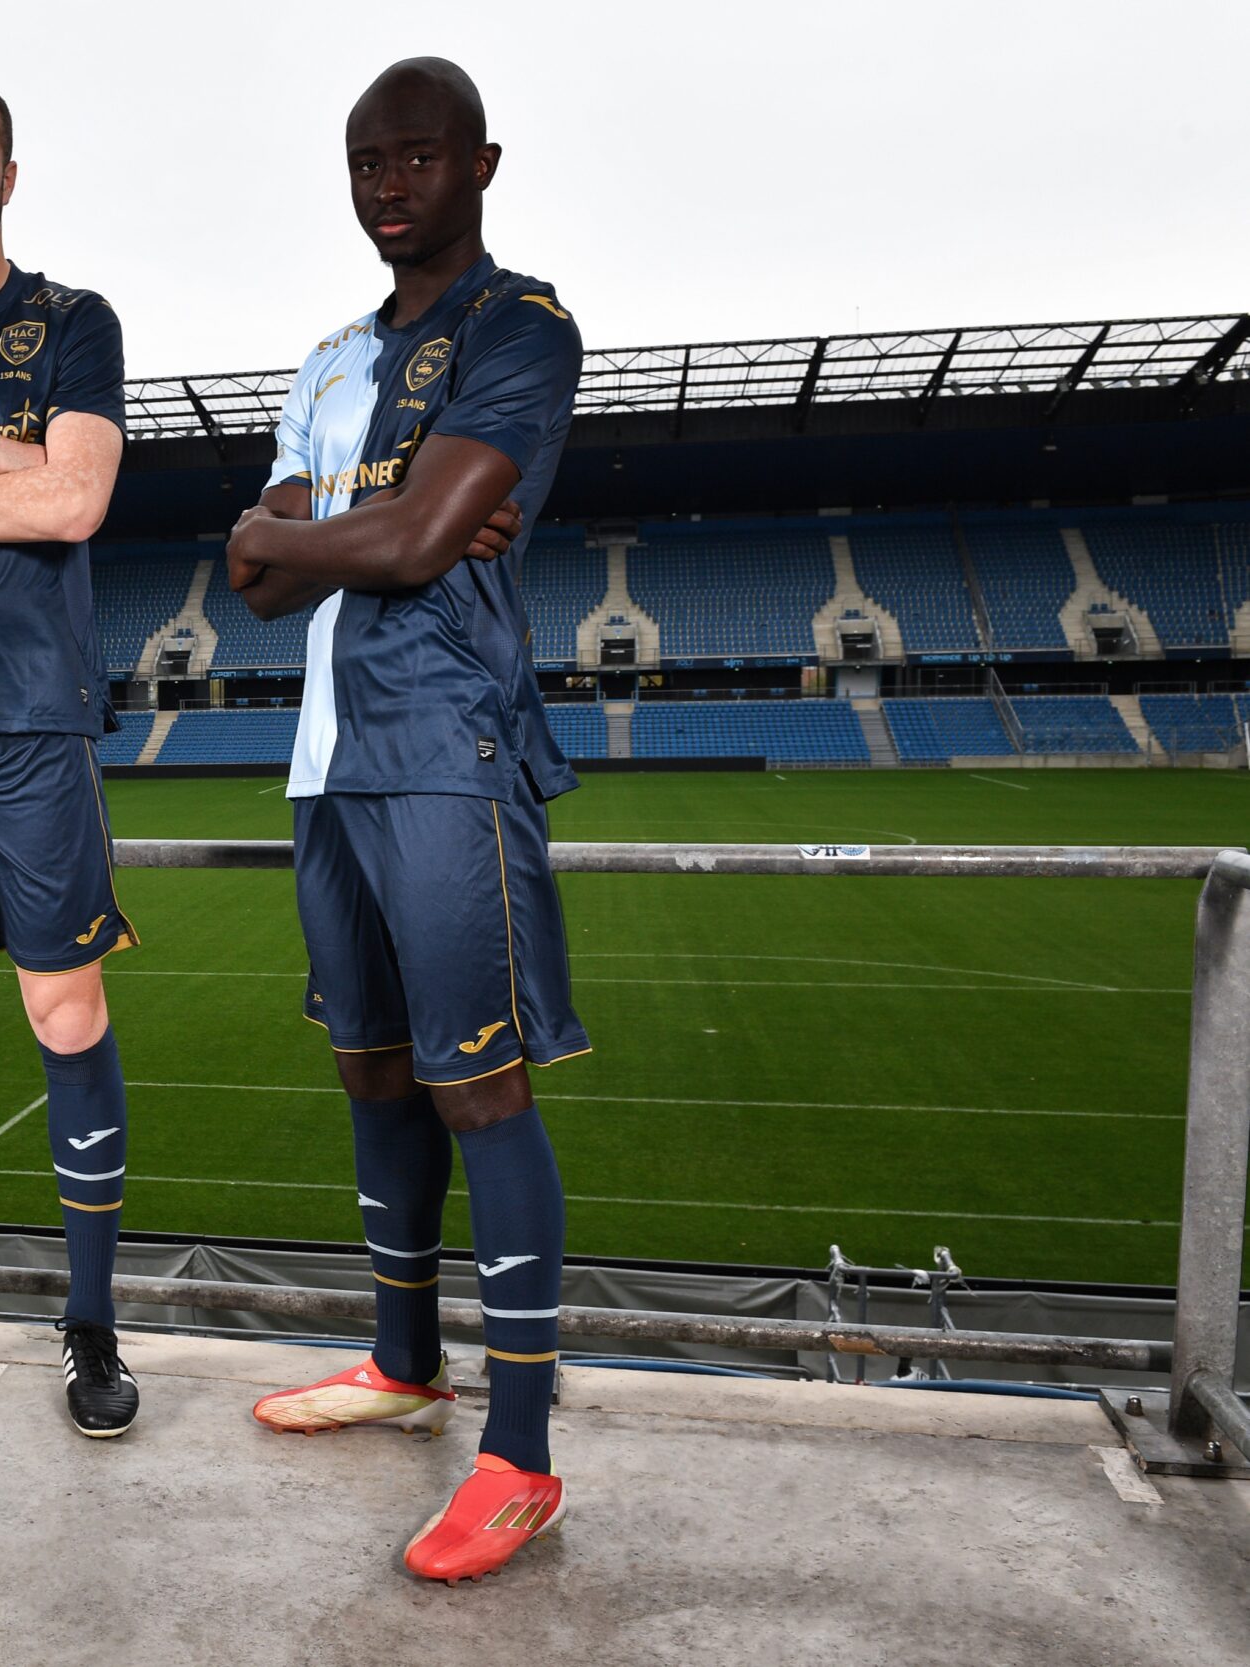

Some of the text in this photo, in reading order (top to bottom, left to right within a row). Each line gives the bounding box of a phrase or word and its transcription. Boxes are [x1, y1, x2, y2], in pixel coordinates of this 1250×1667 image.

[9, 327, 37, 339] HAC
[421, 347, 450, 358] HAC
[0, 370, 33, 382] 150 ANS
[408, 399, 427, 411] ANS
[264, 669, 301, 677] PARMENTIER
